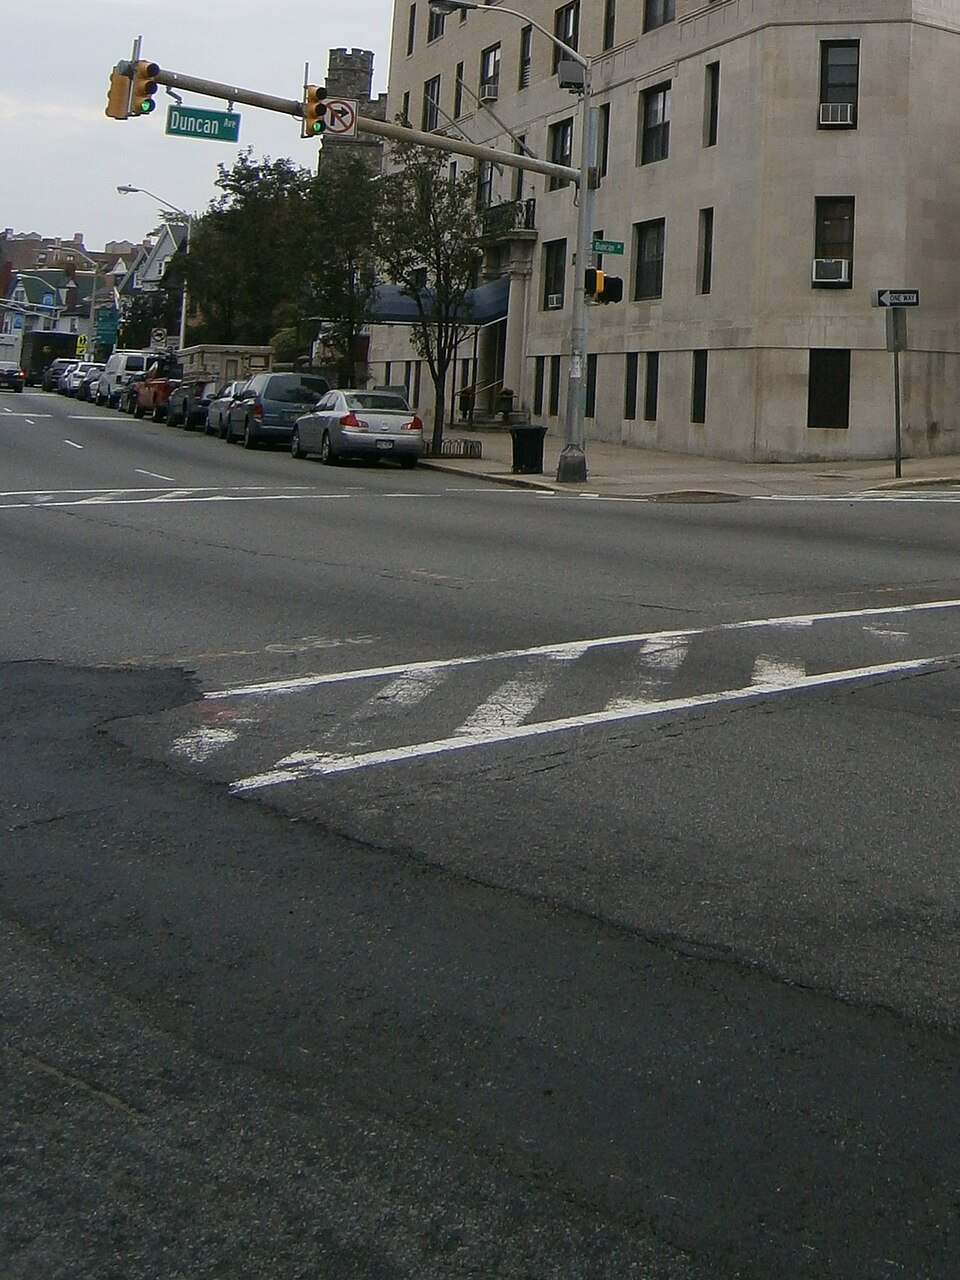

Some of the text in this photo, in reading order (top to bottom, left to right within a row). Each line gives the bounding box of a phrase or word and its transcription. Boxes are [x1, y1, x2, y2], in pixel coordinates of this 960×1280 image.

[171, 111, 236, 135] Duncan Ave
[890, 294, 915, 302] ONE WAY
